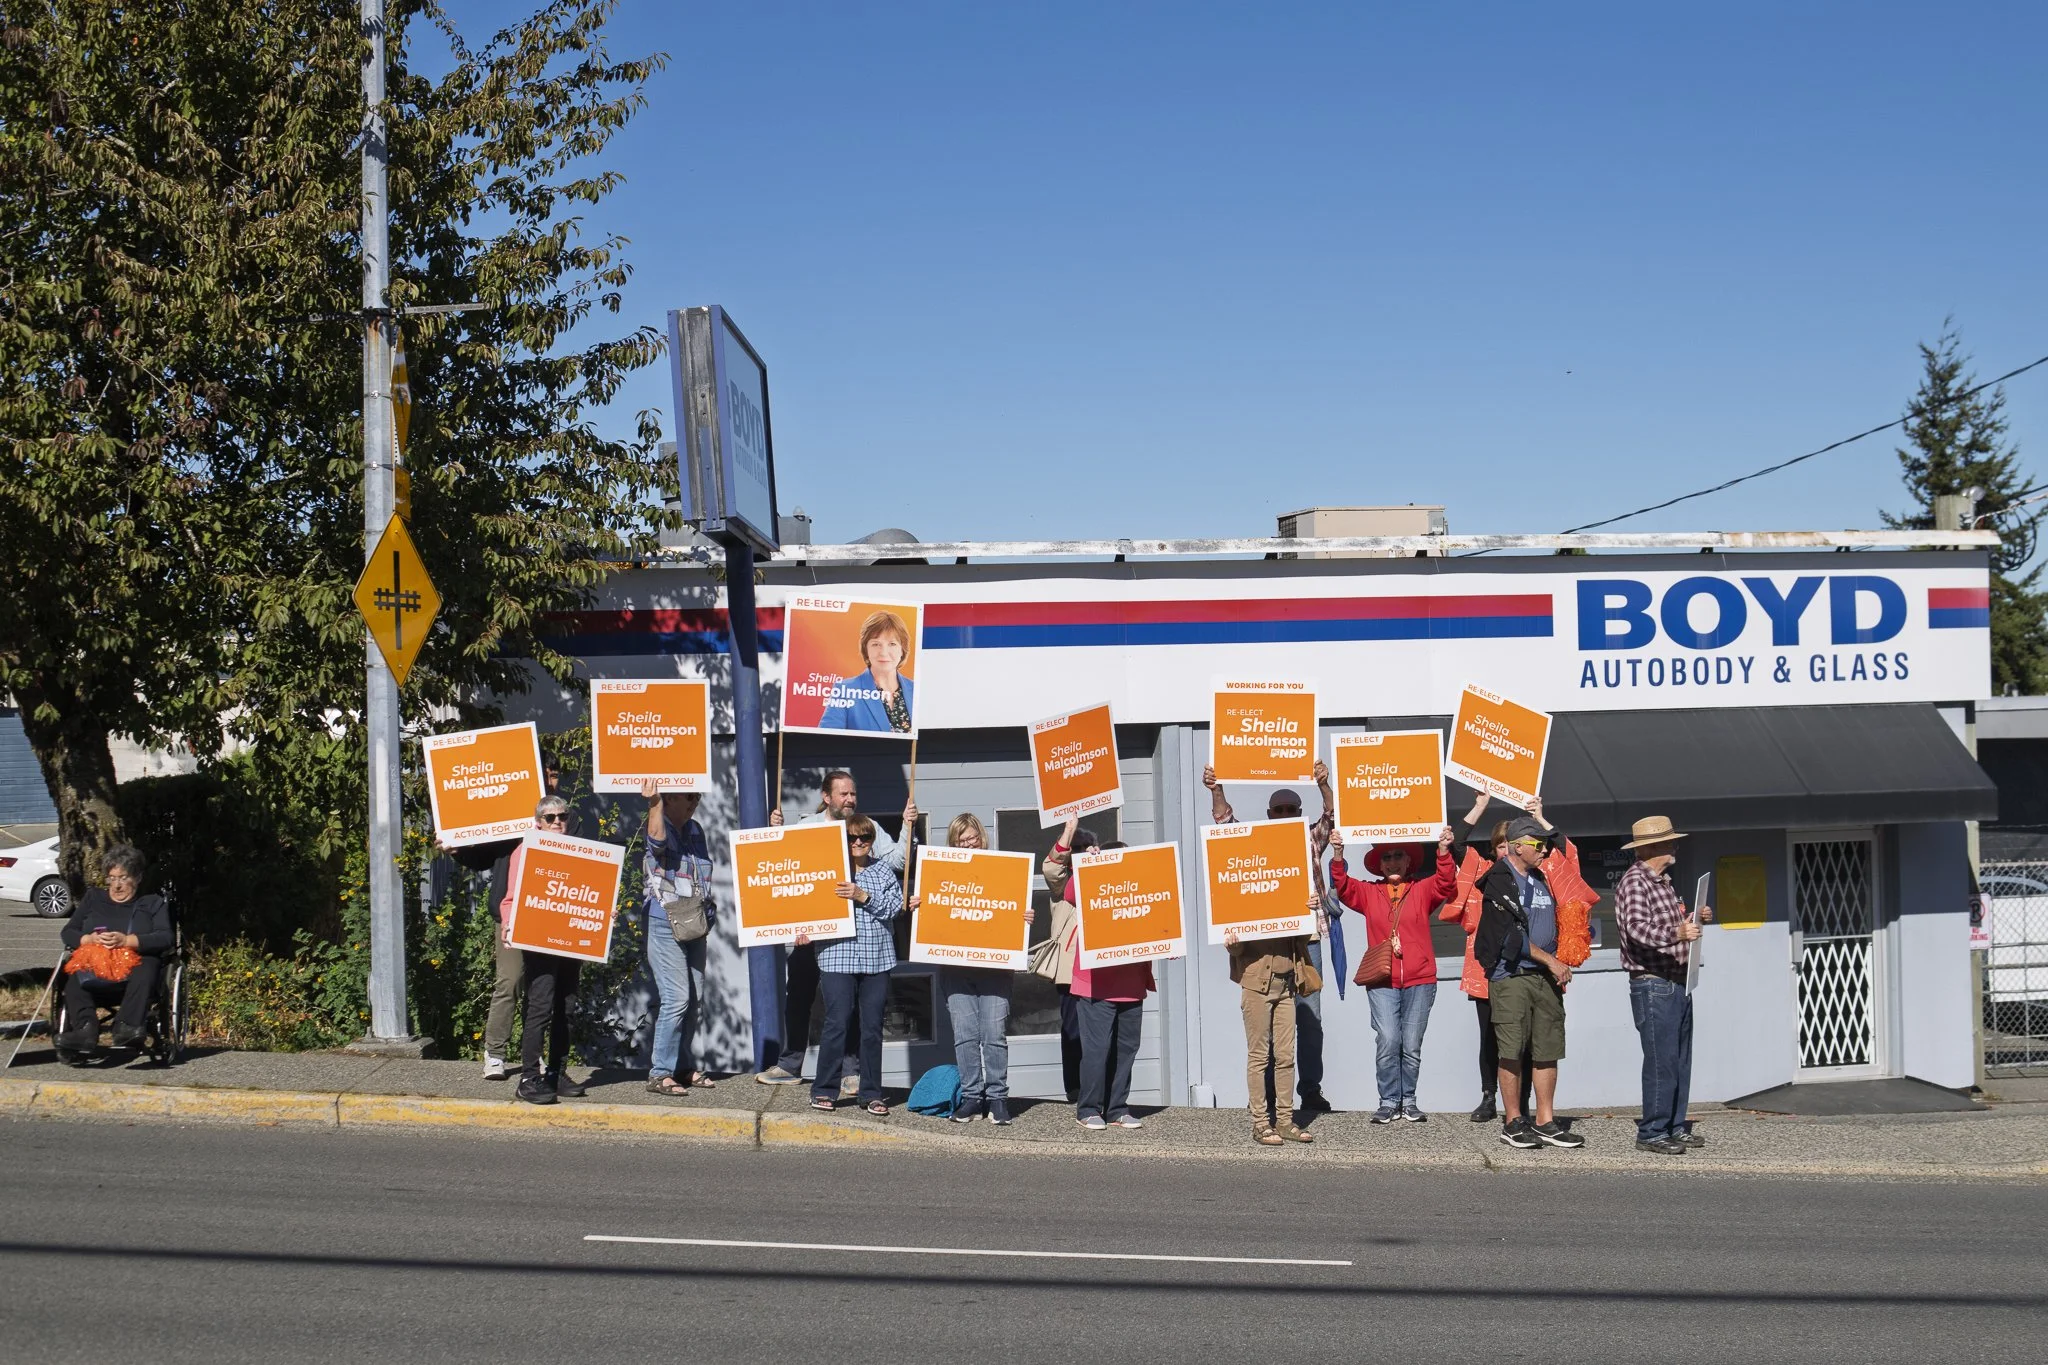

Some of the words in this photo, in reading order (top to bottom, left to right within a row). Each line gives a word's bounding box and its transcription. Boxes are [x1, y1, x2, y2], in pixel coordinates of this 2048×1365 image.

[730, 379, 764, 459] BOYD
[797, 599, 846, 609] RE-ELECT
[1577, 576, 1907, 650] BOYD
[1580, 656, 1755, 688] AUTOBODY
[1773, 656, 1791, 683] &
[1809, 652, 1909, 682] GLASS
[808, 673, 843, 683] Sheila
[792, 683, 891, 701] Malcolmson
[1226, 682, 1266, 690] WORKING
[1468, 684, 1500, 701] RE-ELECT
[618, 712, 661, 723] Sheila
[1036, 718, 1066, 730] RE-ELECT
[1475, 714, 1510, 736] Sheila
[607, 724, 697, 736] Malcolmson
[1240, 718, 1298, 733] Sheila
[433, 736, 472, 747] RE-ELECT
[1222, 735, 1307, 747] Malcolmson
[1340, 736, 1379, 744] RE-ELECT
[1464, 721, 1535, 759] Malcolmson
[1051, 741, 1082, 758] Sheila
[1045, 746, 1108, 772] Malcolmson
[452, 761, 493, 777] Sheila
[1356, 763, 1398, 775] Sheila
[443, 770, 529, 791] Malcolmson
[1347, 774, 1432, 788] Malcolmson
[1459, 768, 1488, 786] ACTION
[1489, 781, 1505, 792] FOR
[1508, 789, 1524, 801] YOU
[1053, 805, 1079, 818] ACTION
[1082, 800, 1095, 810] FOR
[1098, 795, 1112, 805] YOU
[454, 828, 489, 839] ACTION
[492, 825, 510, 833] FOR
[514, 822, 532, 831] YOU
[739, 831, 780, 841] RE-ELECT
[1210, 827, 1248, 836] RE-ELECT
[1352, 829, 1386, 837] ACTION
[539, 838, 576, 852] WORKING
[578, 845, 593, 855] FOR
[595, 848, 610, 858] YOU
[927, 851, 968, 860] RE-ELECT
[757, 859, 800, 873] Sheila
[1082, 854, 1119, 864] RE-ELECT
[1227, 855, 1267, 869] Sheila
[535, 868, 570, 880] RE-ELECT
[747, 869, 836, 887] Malcolmson
[1218, 866, 1300, 884] Malcolmson
[545, 880, 599, 903] Sheila
[939, 881, 983, 895] Sheila
[1099, 881, 1138, 896] Sheila
[525, 895, 604, 920] Malcolmson
[928, 893, 1017, 910] Malcolmson
[1090, 891, 1170, 910] Malcolmson
[756, 928, 792, 938] ACTION
[1224, 925, 1258, 935] ACTION
[1261, 923, 1278, 931] FOR
[1281, 920, 1300, 929] YOU
[547, 937, 572, 946] bcndp.ca
[928, 948, 964, 958] ACTION
[967, 951, 986, 959] FOR
[989, 952, 1010, 961] YOU
[1096, 950, 1129, 960] ACTION
[1132, 947, 1150, 956] FOR
[1152, 944, 1171, 953] YOU
